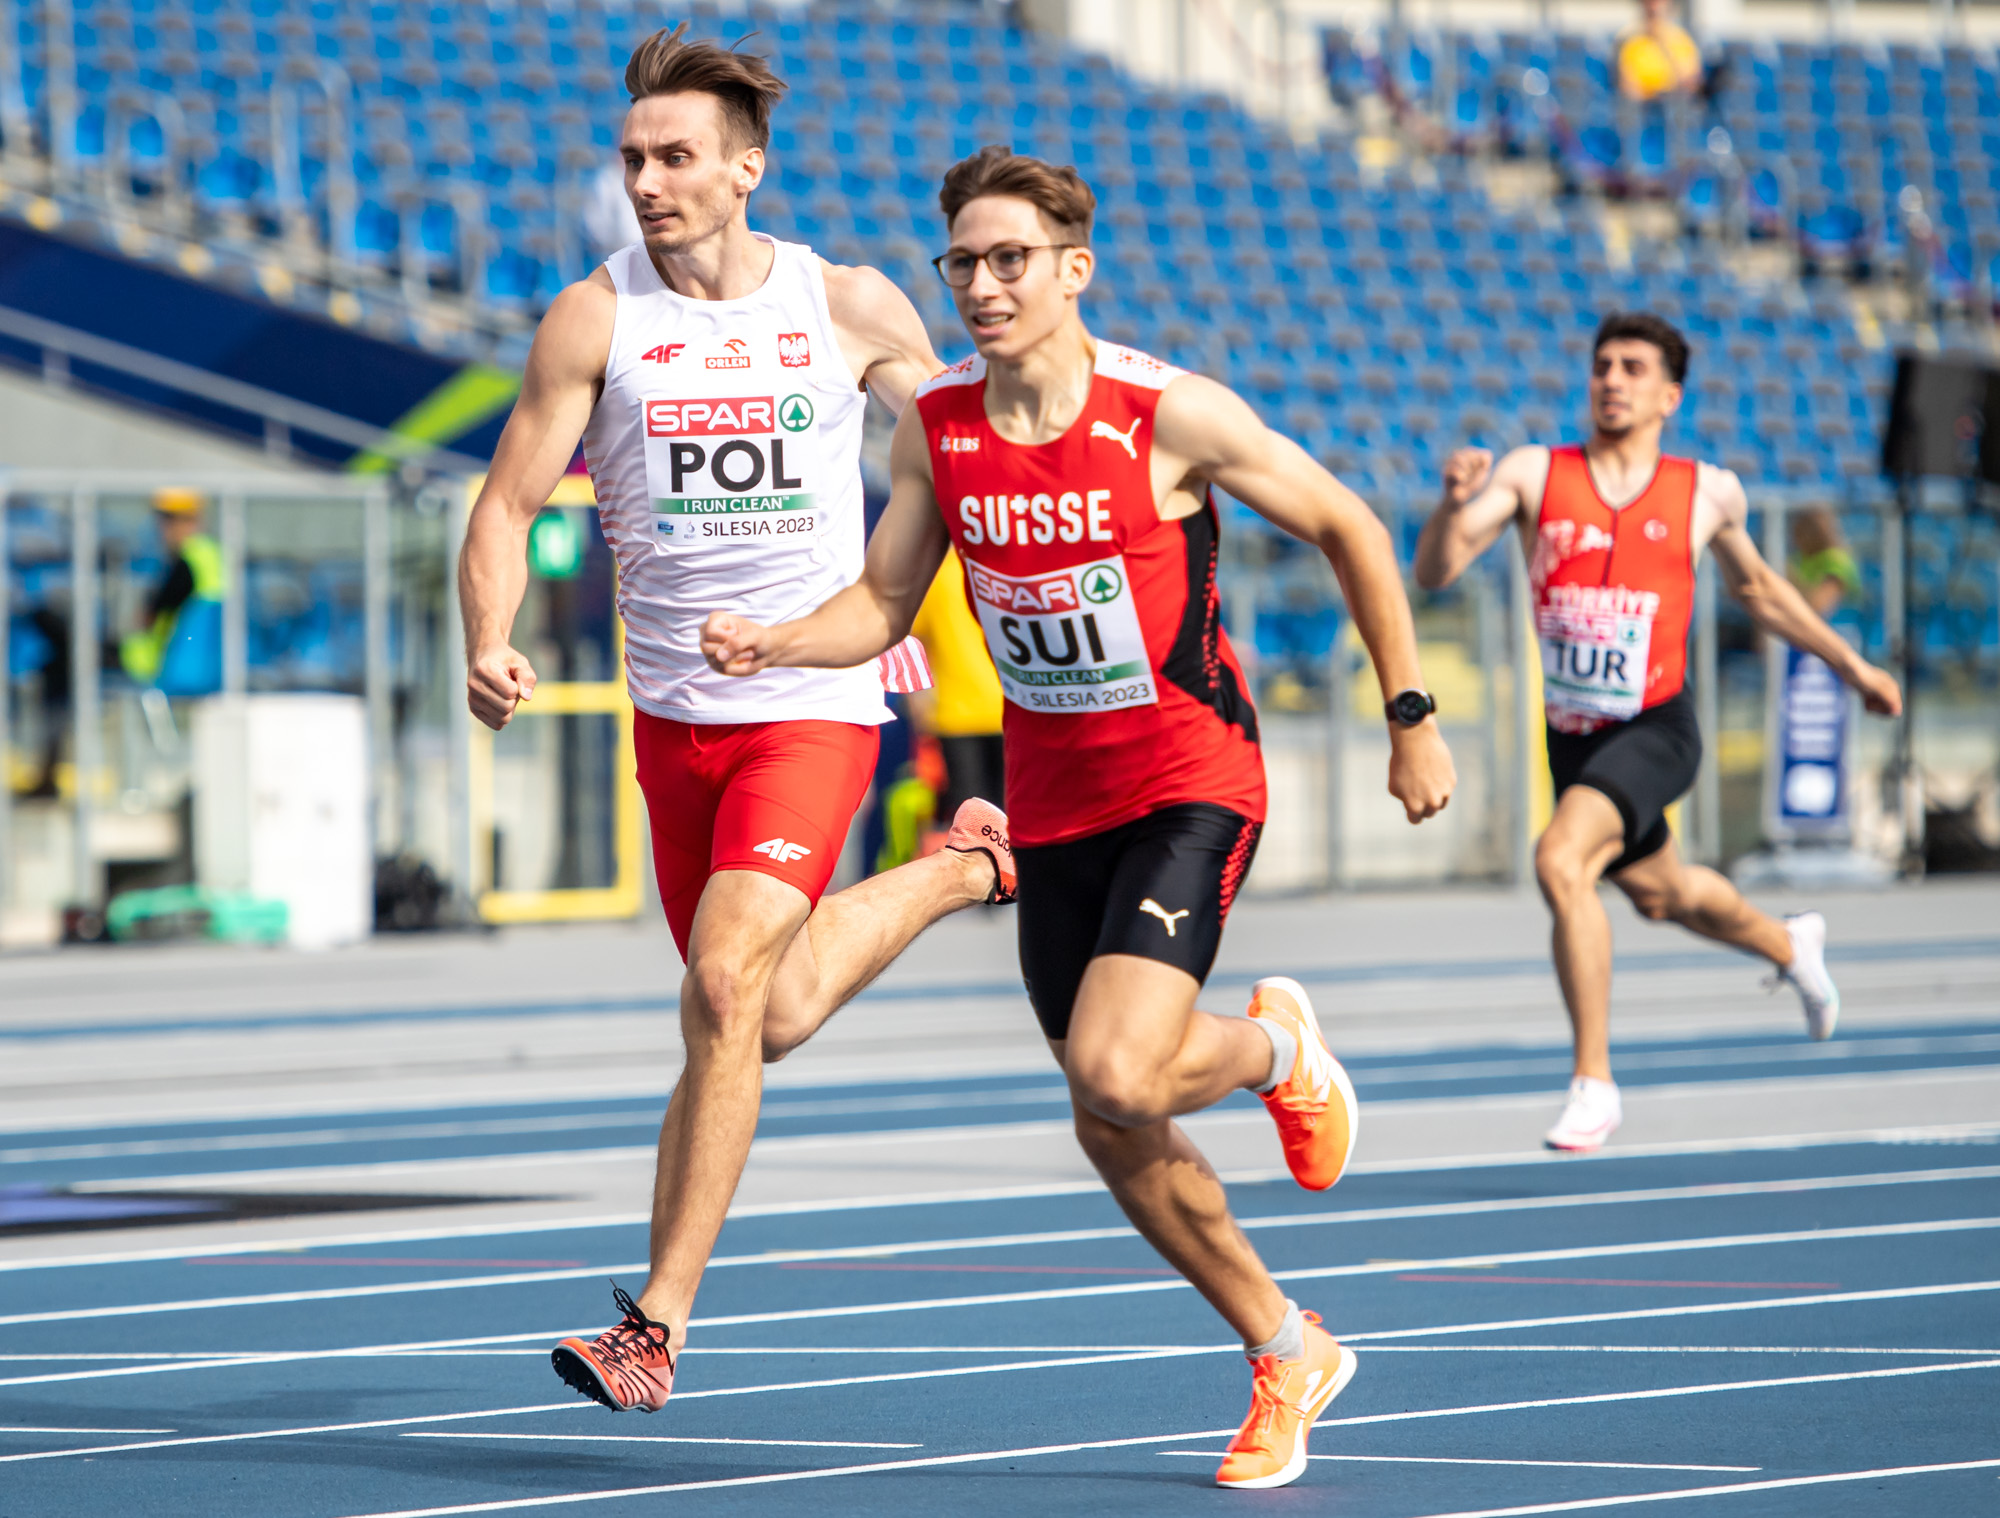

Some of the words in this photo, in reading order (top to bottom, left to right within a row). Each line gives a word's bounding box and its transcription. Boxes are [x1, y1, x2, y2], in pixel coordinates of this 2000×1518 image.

[641, 343, 686, 364] 4F
[706, 357, 749, 369] ORLEN
[650, 401, 771, 432] SPAR
[953, 437, 980, 452] UBS
[669, 438, 802, 493] POL
[684, 500, 688, 512] I
[692, 499, 726, 512] RUN
[702, 520, 772, 537] SILESIA
[776, 516, 815, 534] 2023
[971, 570, 1077, 611] SPAR
[1000, 612, 1107, 667] SUI
[1548, 639, 1627, 682] TUR
[1018, 670, 1049, 685] RUN
[1030, 692, 1099, 707] SILESIA
[1102, 683, 1150, 705] 2023
[753, 838, 811, 863] 4F
